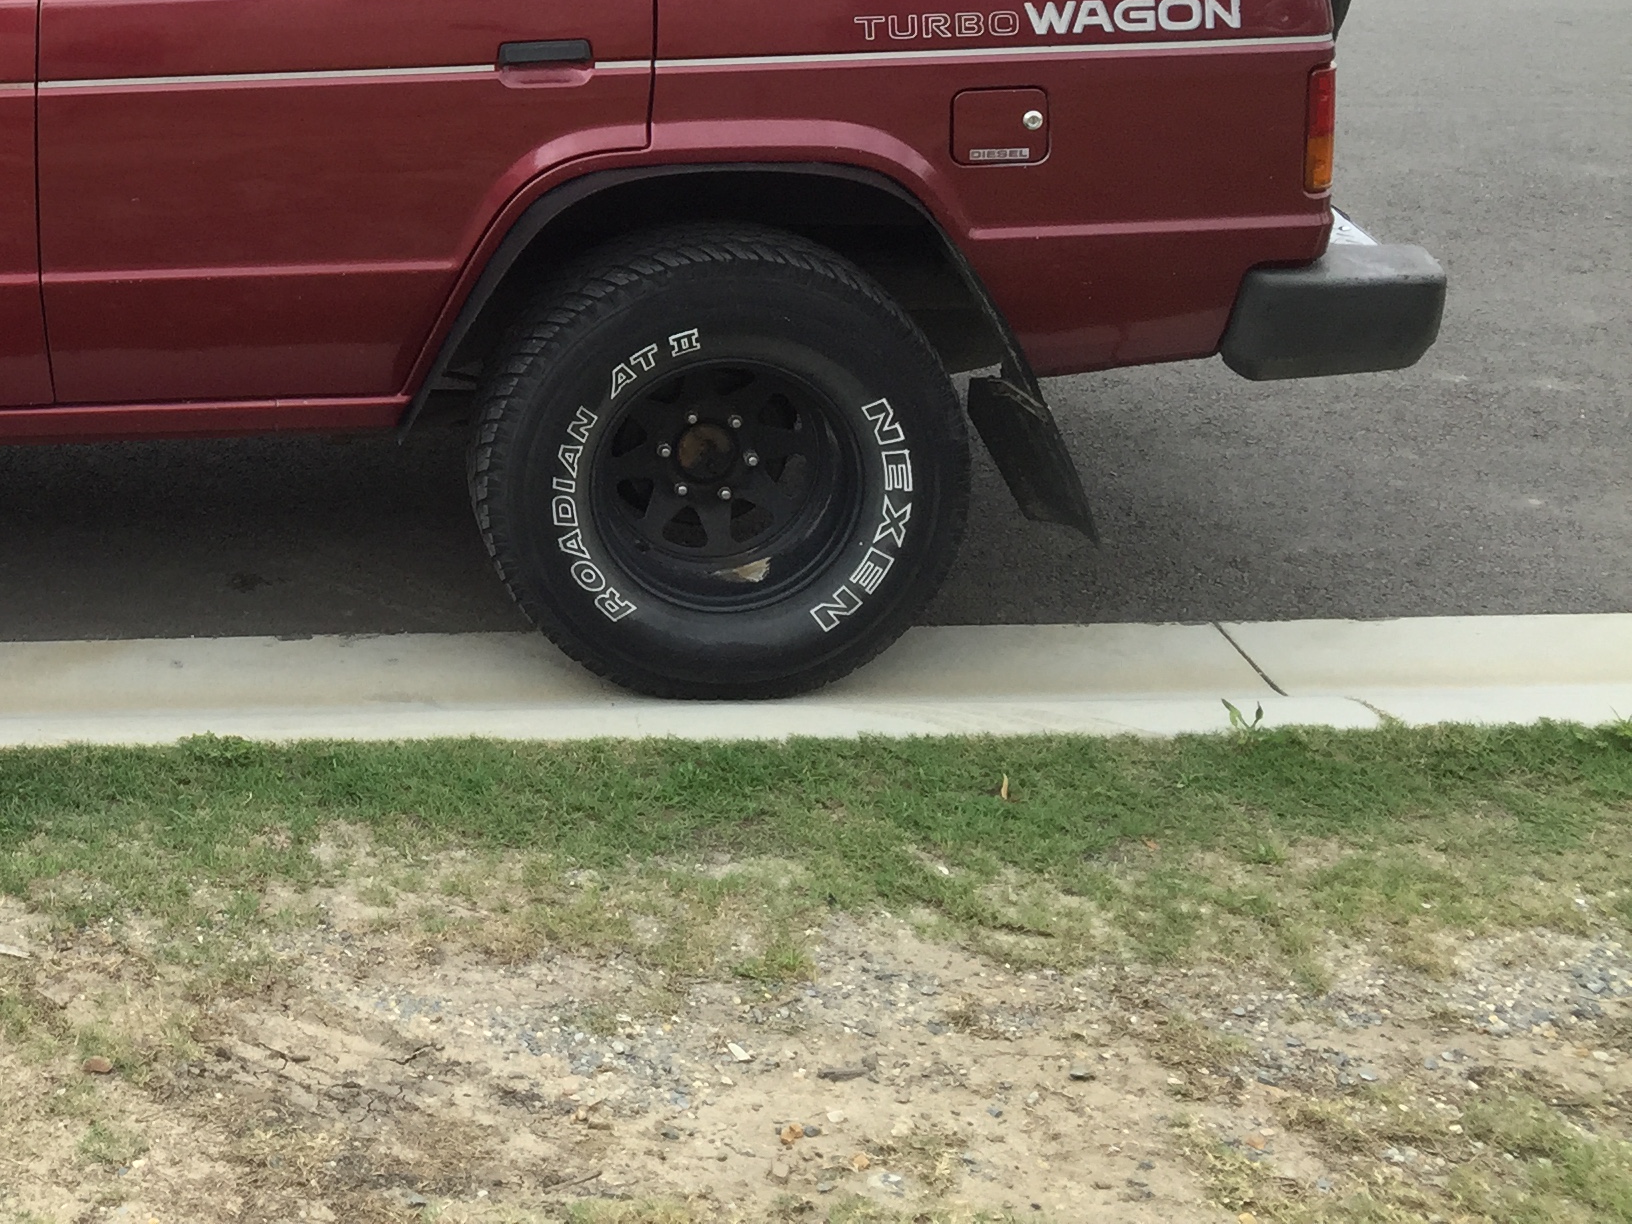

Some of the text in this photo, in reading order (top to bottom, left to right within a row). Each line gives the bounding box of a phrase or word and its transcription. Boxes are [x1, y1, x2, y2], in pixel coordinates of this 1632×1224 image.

[853, 10, 1020, 41] TURBO
[970, 149, 1029, 159] DIESEL
[551, 405, 638, 623] ROADIAN
[610, 343, 658, 400] AT
[809, 397, 913, 633] NEXEN
